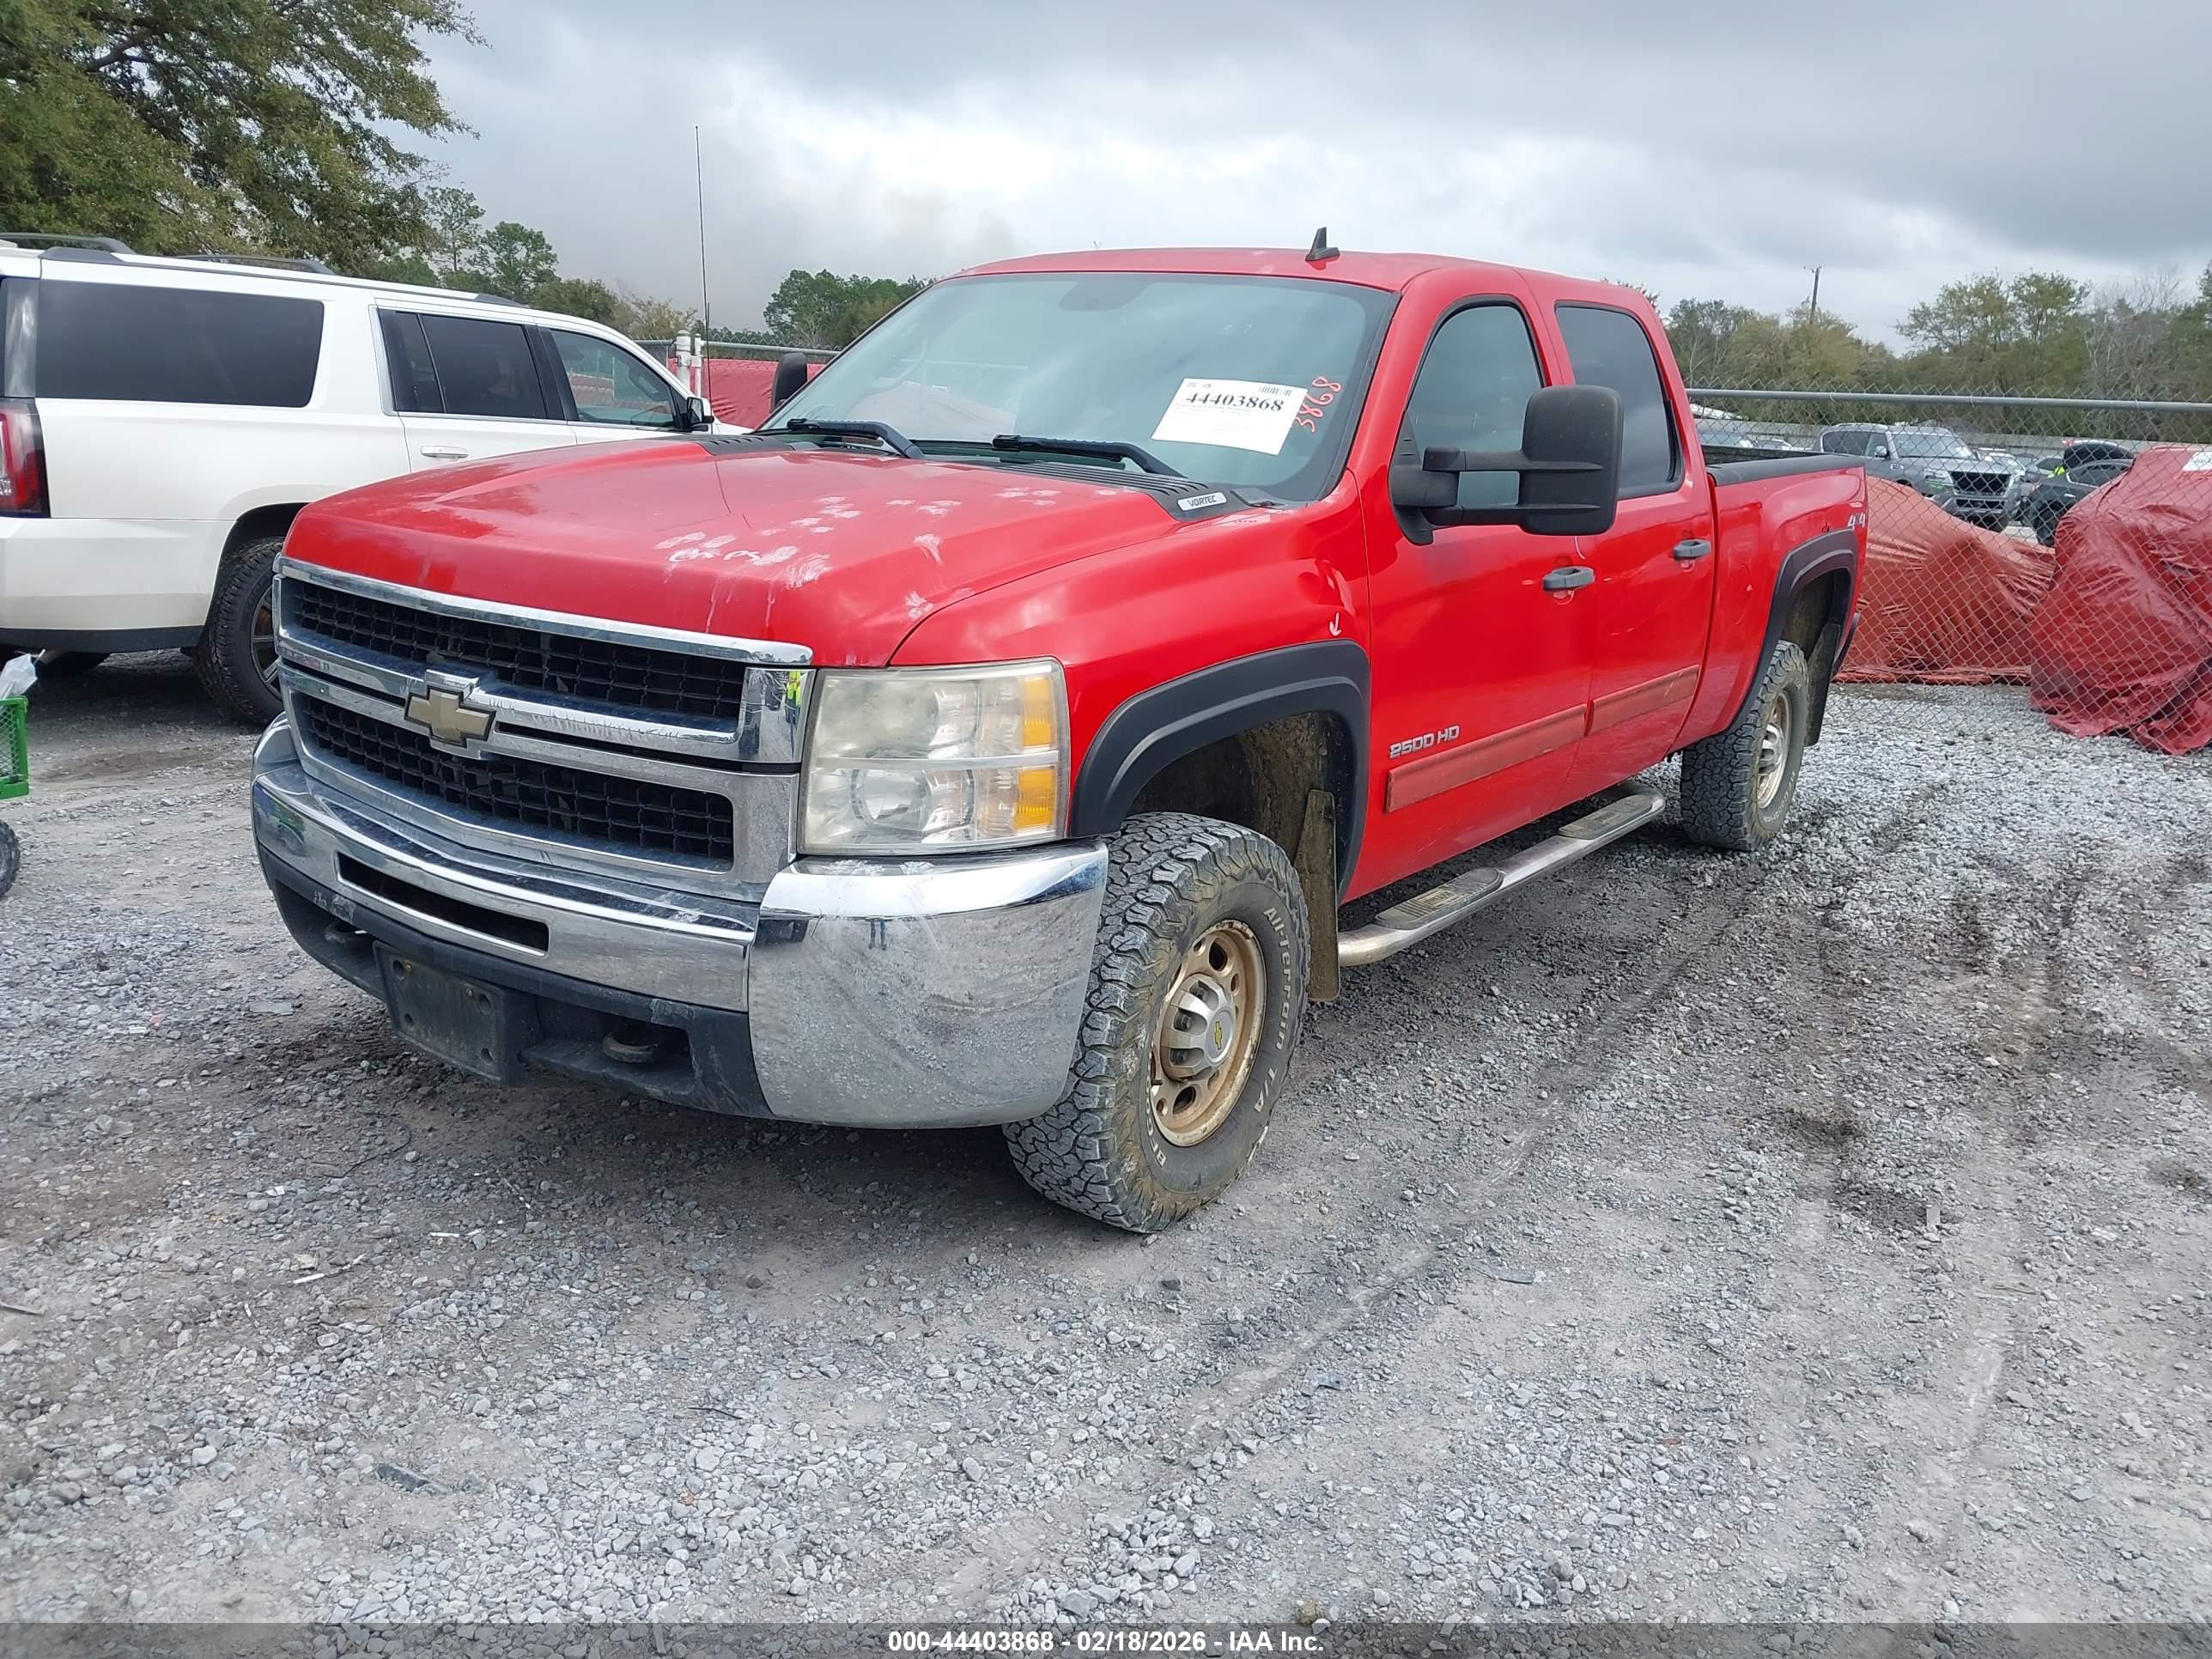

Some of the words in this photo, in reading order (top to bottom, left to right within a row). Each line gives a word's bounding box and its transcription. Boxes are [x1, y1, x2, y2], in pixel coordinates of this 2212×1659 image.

[1186, 392, 1285, 412] 44403868
[1295, 375, 1341, 433] 3868
[1187, 495, 1217, 507] VORTEC
[1389, 733, 1435, 759] 2500
[1437, 725, 1460, 744] HD
[1262, 907, 1291, 1050] All-Terrain
[1254, 1067, 1278, 1113] T/A
